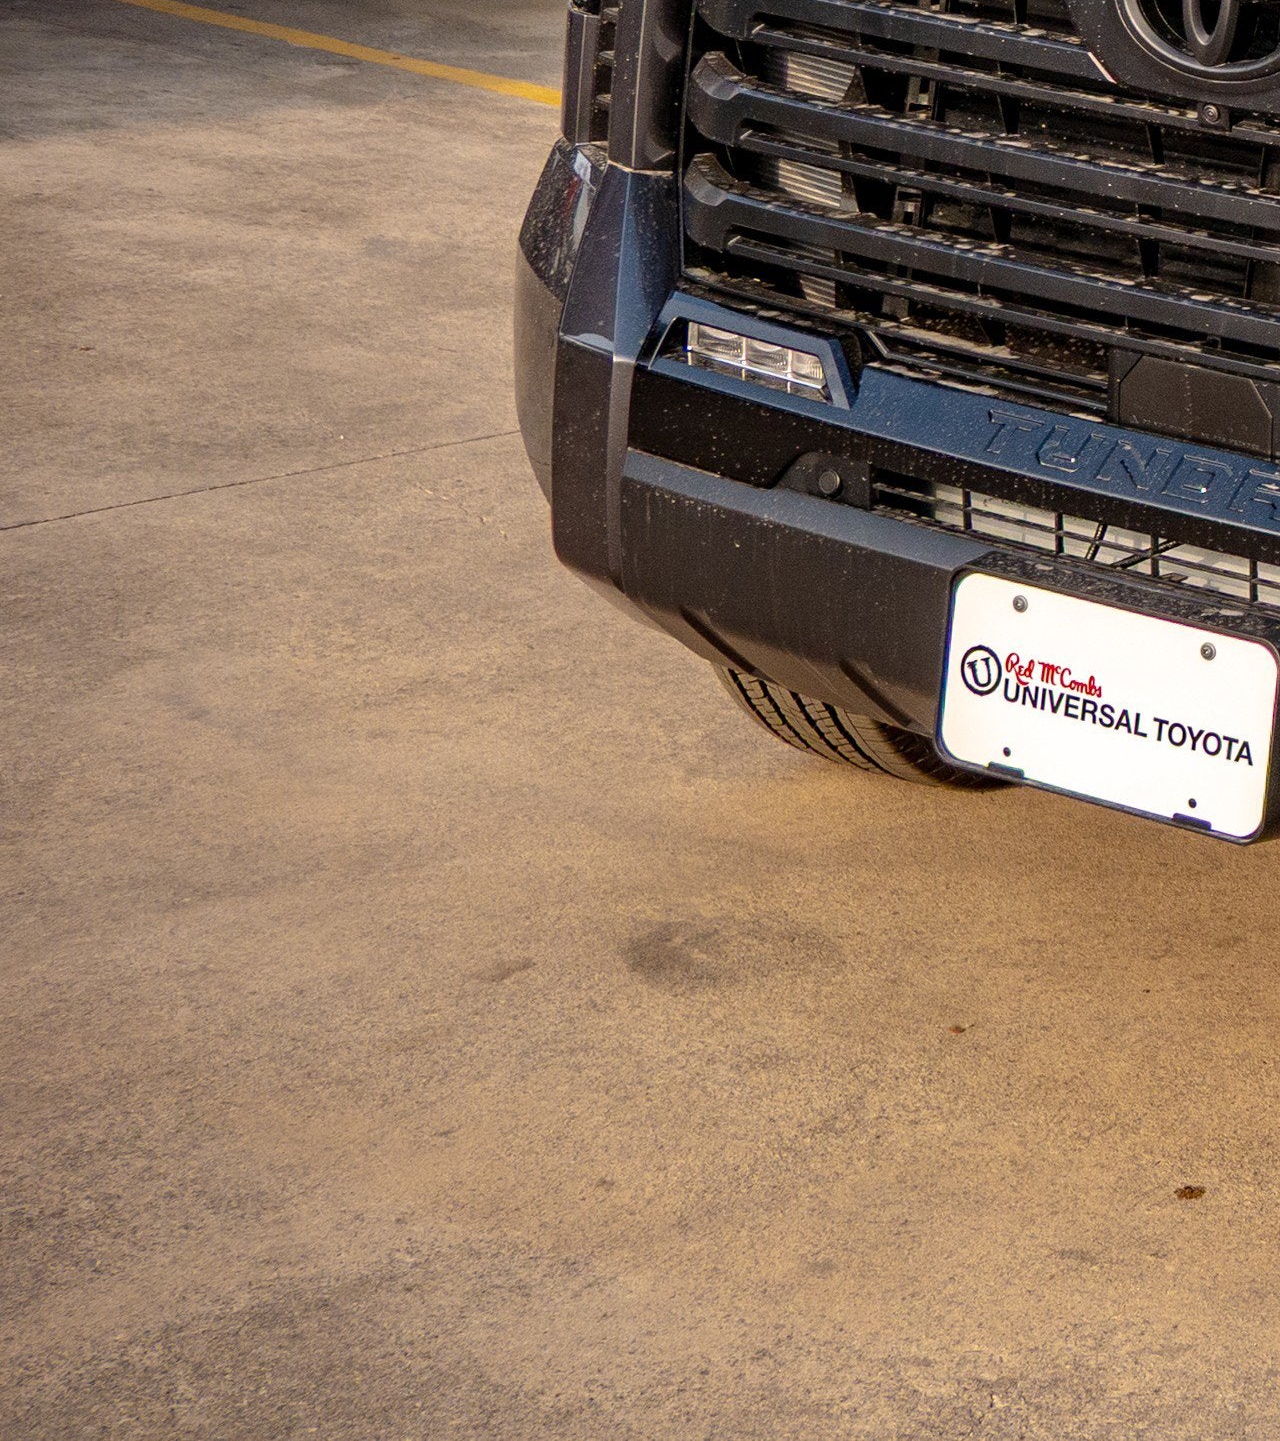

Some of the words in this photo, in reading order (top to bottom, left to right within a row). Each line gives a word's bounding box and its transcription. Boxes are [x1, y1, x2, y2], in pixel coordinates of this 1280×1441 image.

[1004, 651, 1036, 686] Red
[1037, 659, 1103, 699] McCombs
[1003, 677, 1148, 738] UNIVERSAL
[1152, 717, 1254, 766] TOYOTA
